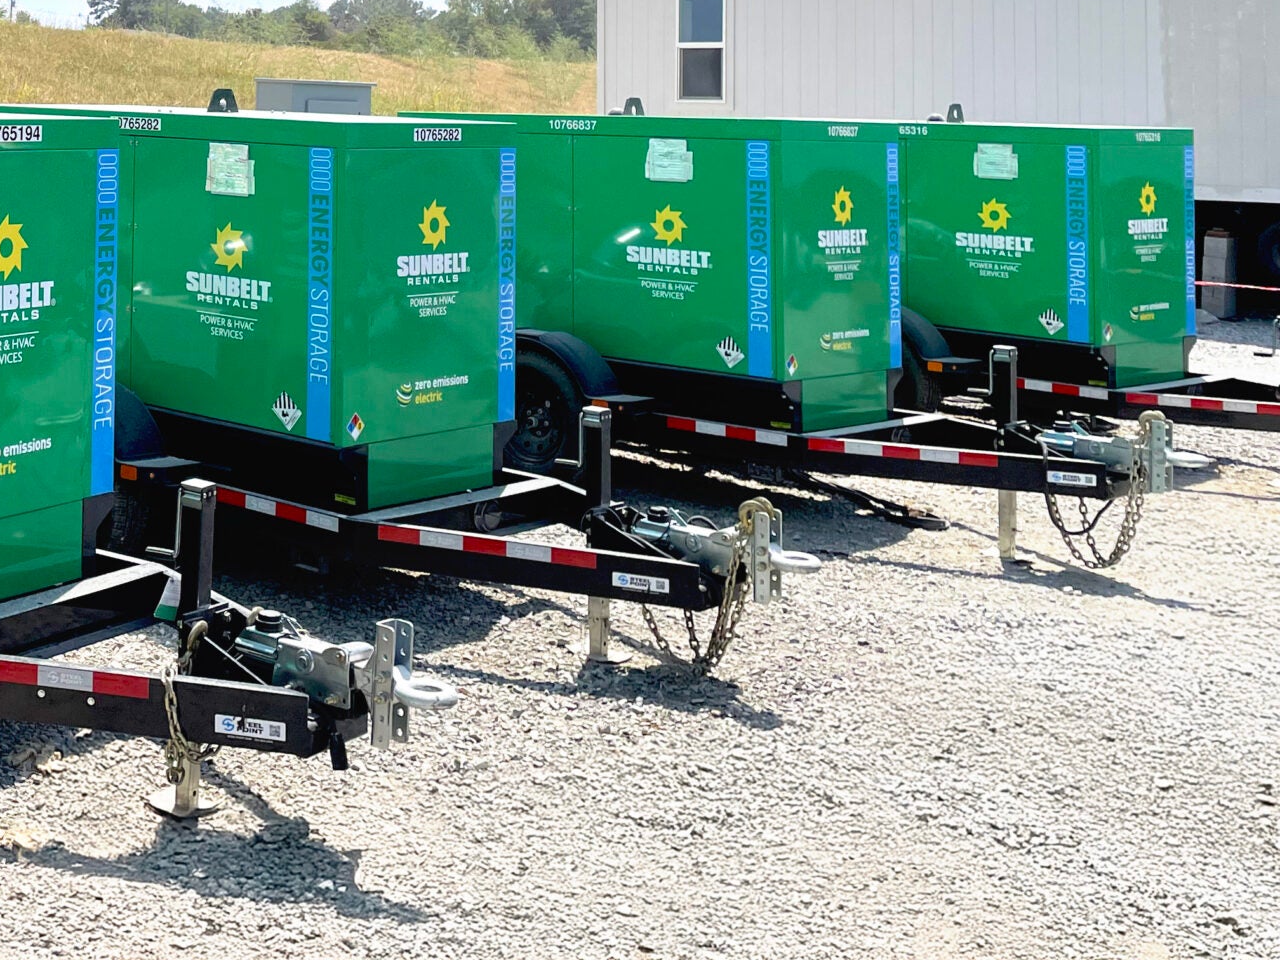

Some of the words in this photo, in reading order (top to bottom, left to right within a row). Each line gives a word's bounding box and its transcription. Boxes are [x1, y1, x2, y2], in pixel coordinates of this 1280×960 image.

[549, 120, 597, 130] 10766837
[898, 126, 928, 135] 65316
[415, 129, 460, 141] 10765282
[749, 179, 767, 254] ENERGY
[1069, 178, 1085, 241] ENERGY
[310, 194, 329, 289] ENERGY
[500, 196, 514, 282] ENERGY
[818, 229, 867, 248] SUNBELT
[955, 232, 1033, 252] SUNBELT
[96, 207, 115, 314] ENERGY
[397, 252, 469, 277] SUNBELT
[626, 245, 711, 268] SUNBELT
[638, 264, 698, 275] RENTALS
[1069, 241, 1086, 306] STORAGE
[186, 271, 271, 302] SUNBELT
[407, 274, 459, 286] RENTALS
[641, 280, 667, 290] POWER
[674, 283, 695, 292] HVAC
[410, 297, 432, 307] POWER
[440, 295, 456, 304] HVAC
[652, 290, 684, 300] SERVICES
[749, 255, 768, 333] STORAGE
[889, 255, 900, 328] STORAGE
[197, 294, 258, 310] RENTALS
[419, 306, 447, 317] SERVICES
[200, 314, 225, 326] POWER
[227, 319, 233, 328] &
[234, 320, 254, 332] HVAC
[500, 283, 514, 372] STORAGE
[210, 327, 243, 340] SERVICES
[310, 288, 328, 385] STORAGE
[4, 340, 10, 351] &
[12, 336, 35, 350] HVAC
[94, 317, 114, 430] STORAGE
[415, 379, 432, 390] zero
[432, 374, 469, 388] emissions
[415, 390, 443, 404] electric
[3, 437, 52, 457] emissions
